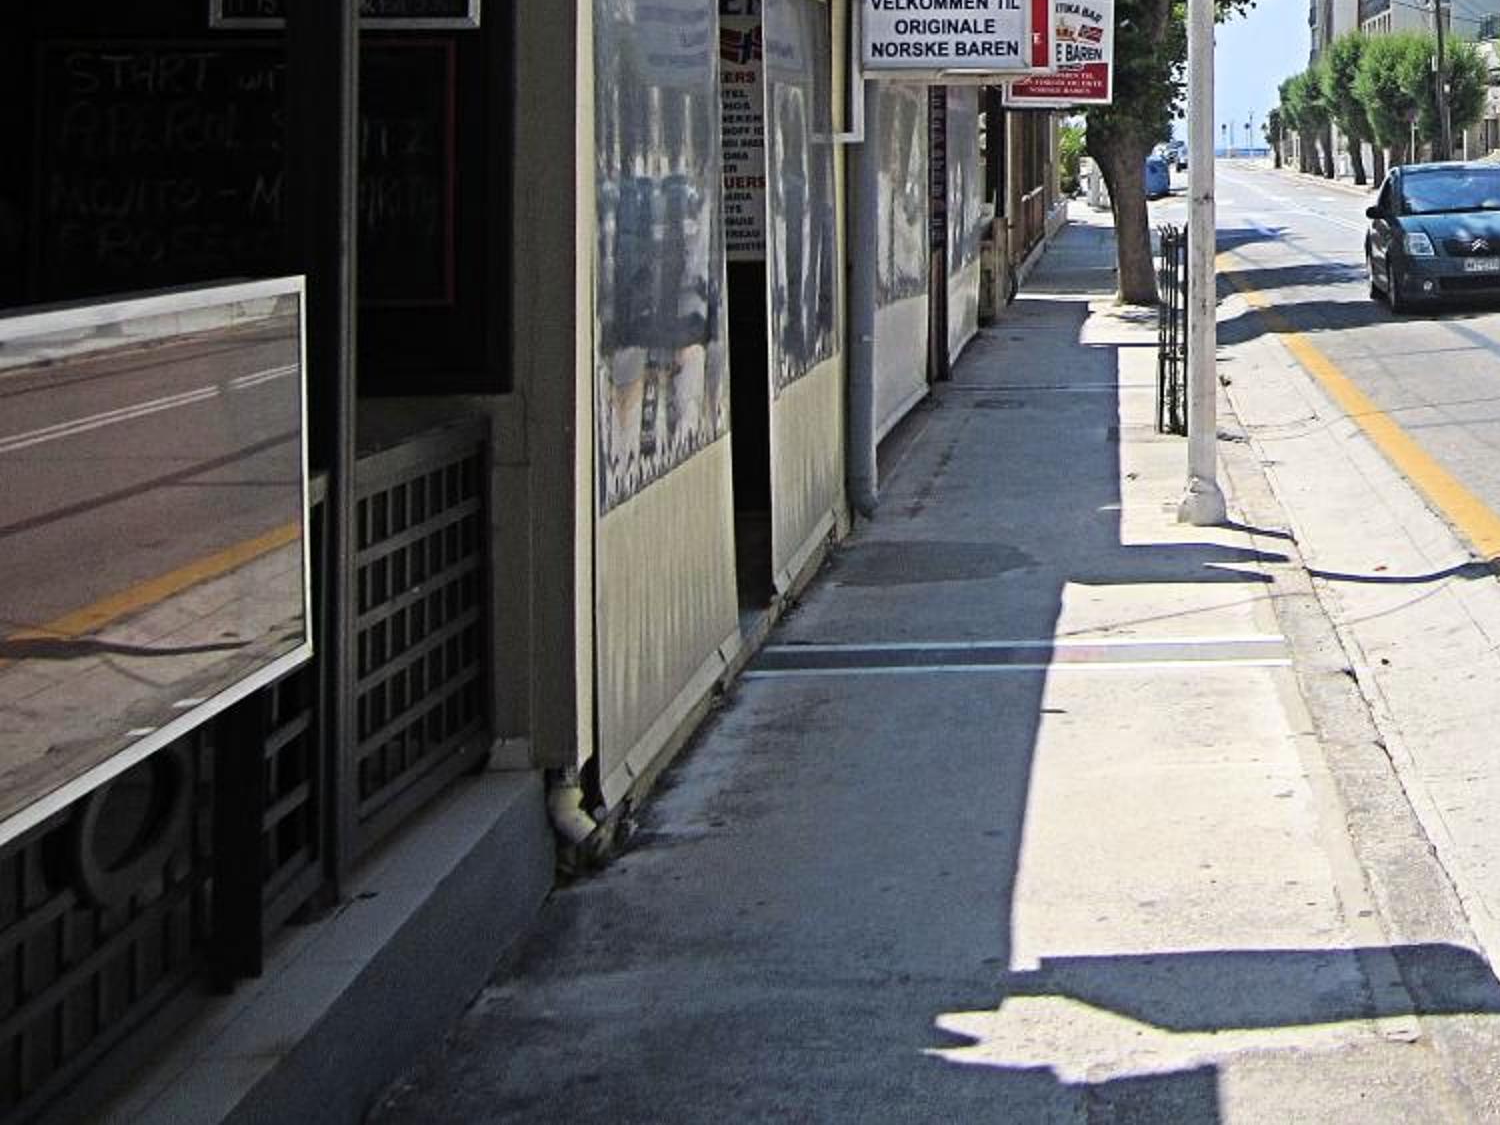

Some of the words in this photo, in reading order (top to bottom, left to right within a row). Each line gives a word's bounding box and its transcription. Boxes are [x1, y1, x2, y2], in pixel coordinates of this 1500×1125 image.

[895, 18, 996, 36] ORIGINALE
[871, 42, 950, 58] NORSKE
[955, 41, 1020, 57] BAREN
[1065, 43, 1103, 63] BAREN
